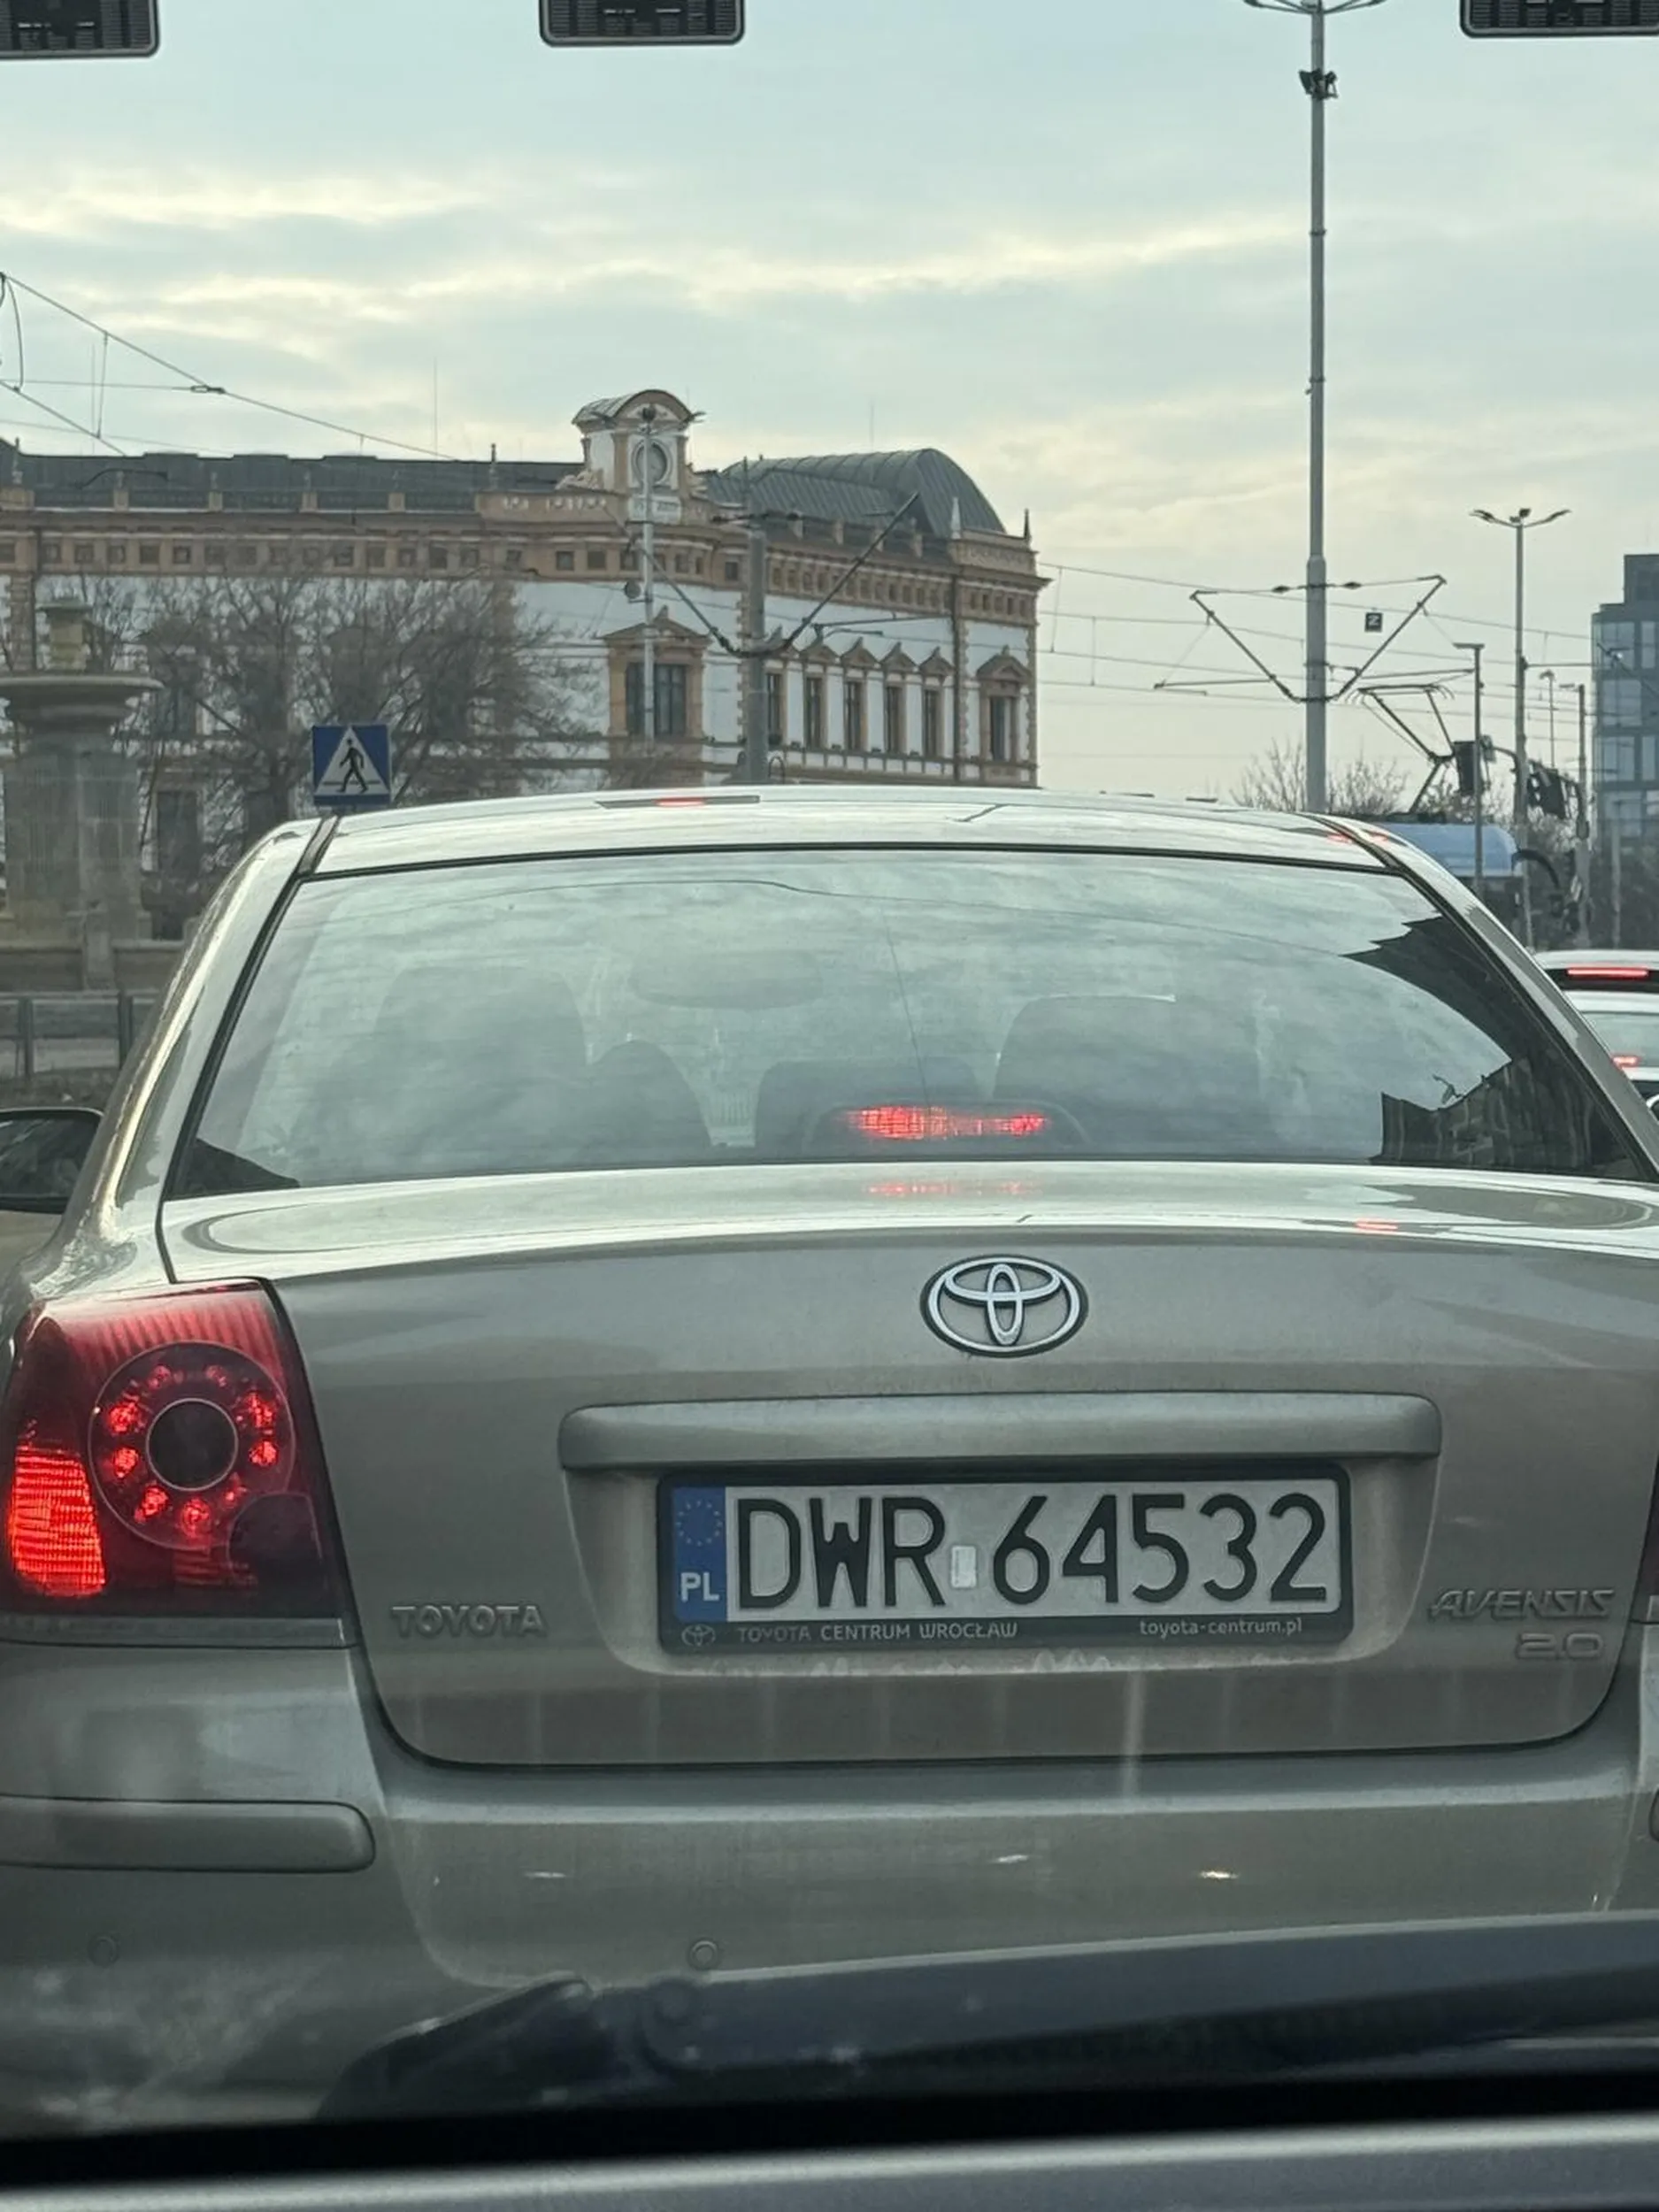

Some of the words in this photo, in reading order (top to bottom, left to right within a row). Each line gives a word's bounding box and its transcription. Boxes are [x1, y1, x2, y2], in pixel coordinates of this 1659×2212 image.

[737, 1496, 947, 1609] DWR
[992, 1492, 1327, 1605] 64532
[680, 1571, 720, 1602] PL
[1430, 1588, 1615, 1620] AVENSIS
[391, 1604, 547, 1638] TOYOTA
[737, 1625, 810, 1643] TOYOTA
[820, 1624, 911, 1640] CENTRUM
[918, 1622, 1018, 1639] WROCŁAW
[1139, 1617, 1303, 1640] toyota-centrum.pl
[1517, 1632, 1604, 1660] 2.0
